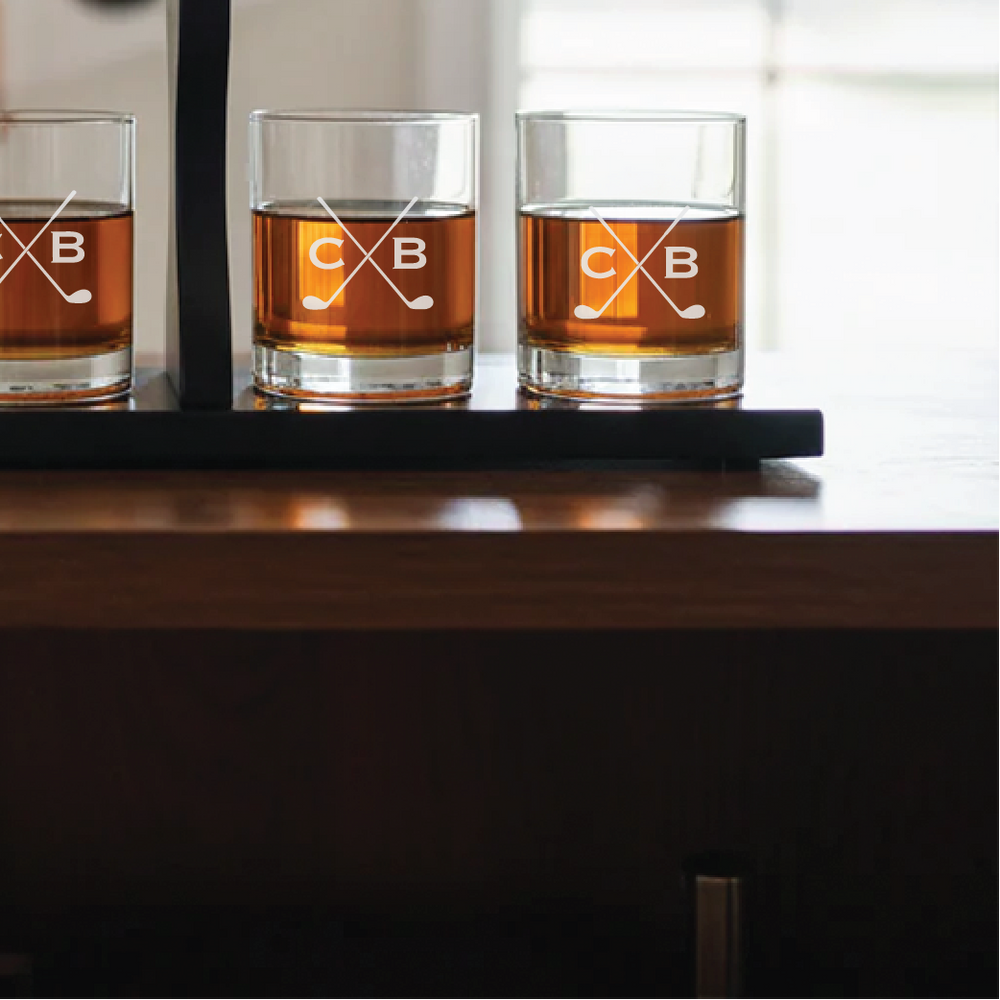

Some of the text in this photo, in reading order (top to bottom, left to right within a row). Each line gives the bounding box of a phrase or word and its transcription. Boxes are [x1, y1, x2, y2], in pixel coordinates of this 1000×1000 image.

[52, 231, 85, 263] B
[309, 238, 427, 269] C B
[581, 247, 699, 278] C B
